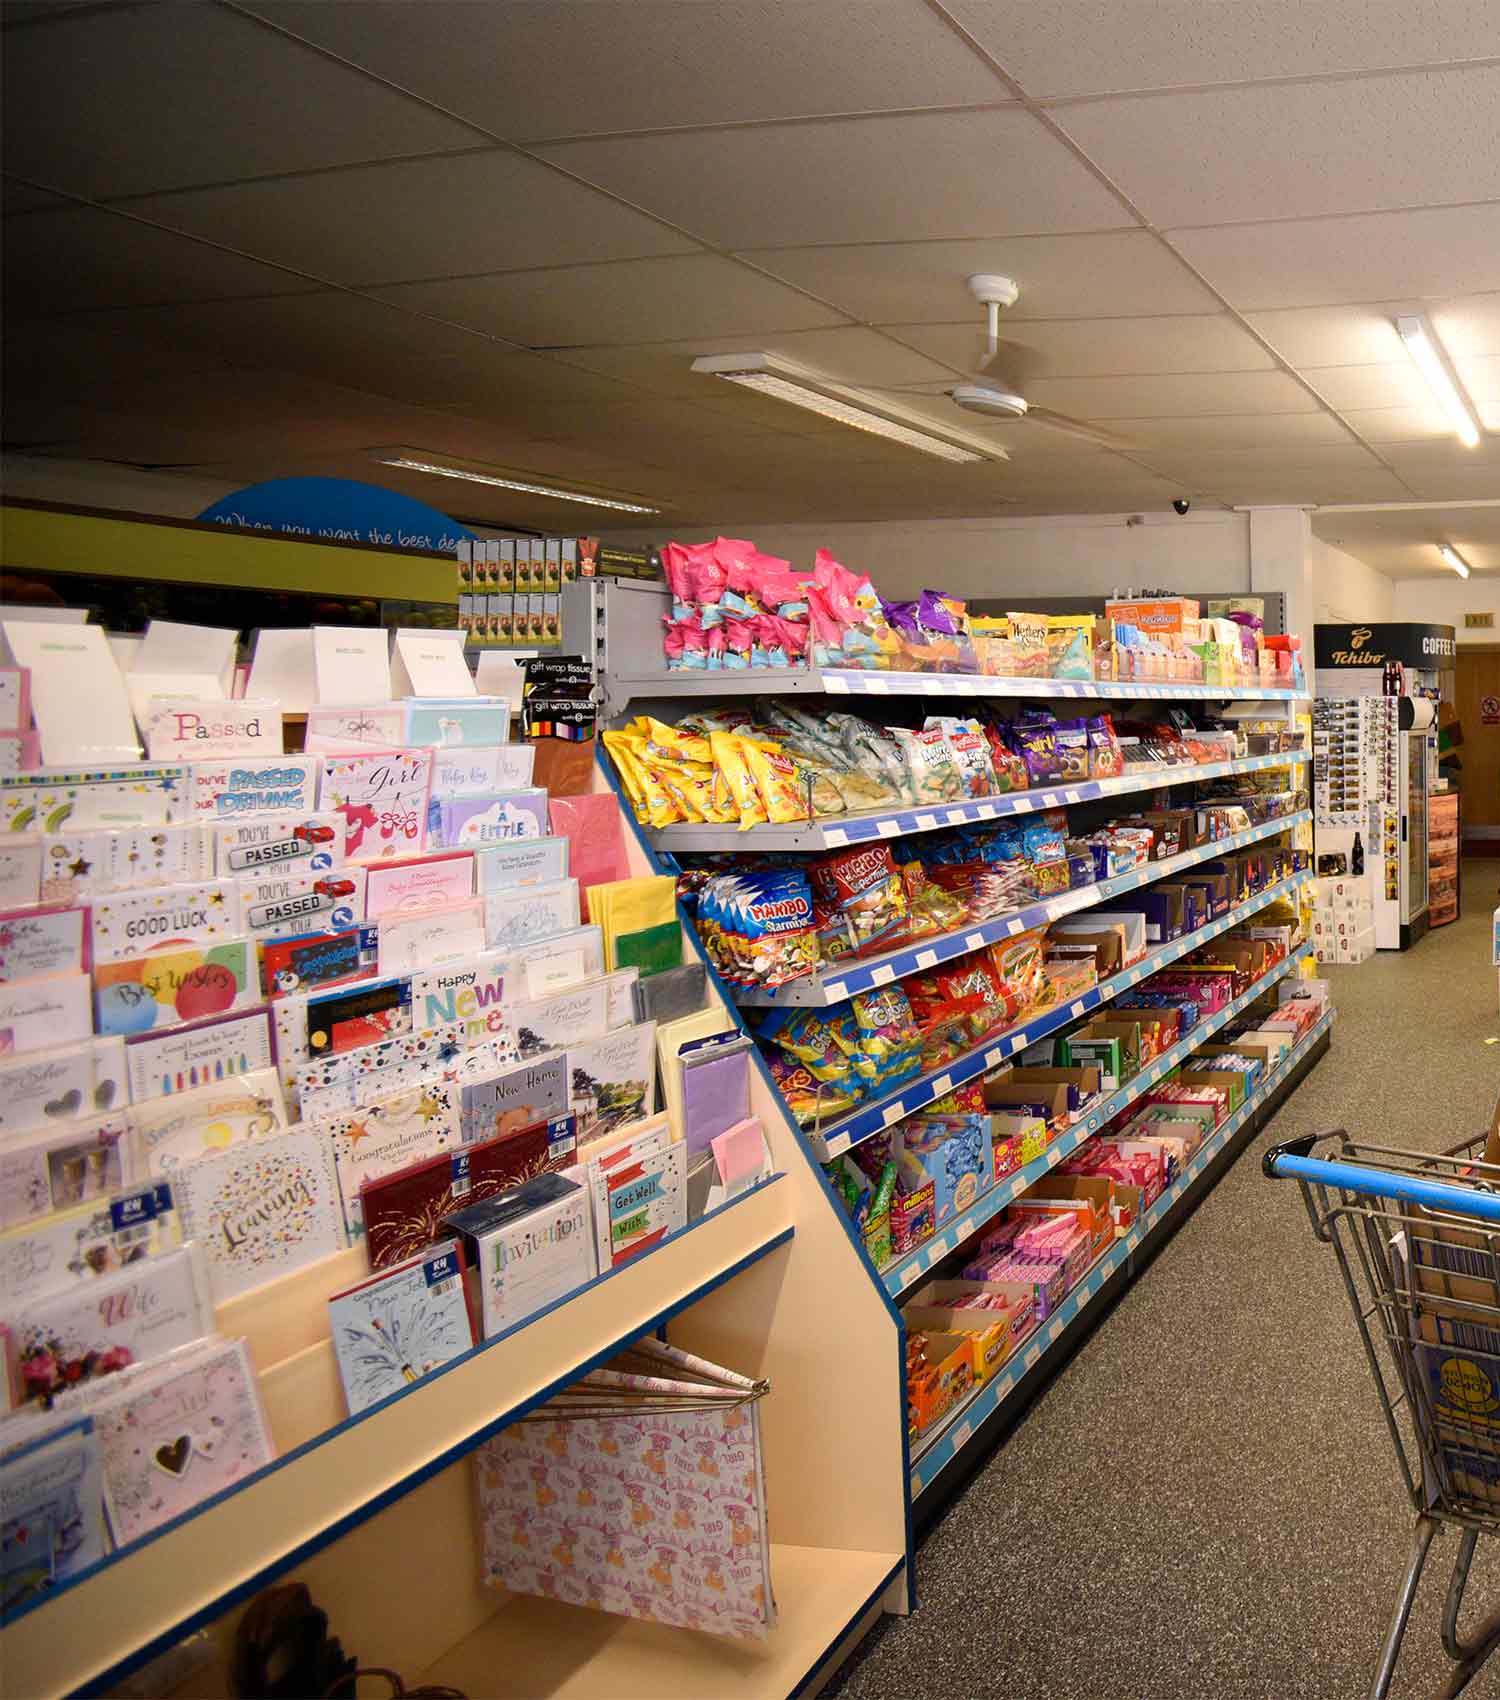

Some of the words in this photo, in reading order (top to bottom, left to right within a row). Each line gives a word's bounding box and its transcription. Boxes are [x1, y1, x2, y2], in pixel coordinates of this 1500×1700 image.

[318, 527, 361, 543] want
[368, 527, 393, 545] the
[396, 529, 433, 548] best
[1332, 651, 1386, 665] Tchibo
[1421, 637, 1451, 655] COFFEE
[530, 660, 545, 673] gift
[545, 664, 567, 674] wrap
[567, 663, 591, 673] tissue
[535, 702, 549, 712] gift
[550, 702, 571, 711] wrap
[571, 702, 595, 710] tissue
[173, 713, 263, 741] Passed
[237, 825, 270, 844] YOU'VE
[245, 841, 300, 864] PASSED
[834, 847, 887, 881] HARIBO
[257, 881, 290, 899] YOU'VE
[265, 896, 320, 921] PASSED
[749, 896, 809, 922] HARIBO
[126, 915, 169, 938] GOOD
[172, 909, 208, 931] LUCK
[437, 971, 476, 989] Happy
[424, 976, 505, 1028] New
[495, 1081, 520, 1101] New
[526, 1068, 560, 1089] Home
[614, 1193, 634, 1210] Get
[635, 1181, 657, 1203] Well
[903, 1185, 934, 1212] millions
[221, 1175, 312, 1252] Leaving
[618, 1217, 642, 1236] With
[494, 1209, 585, 1274] Invitation
